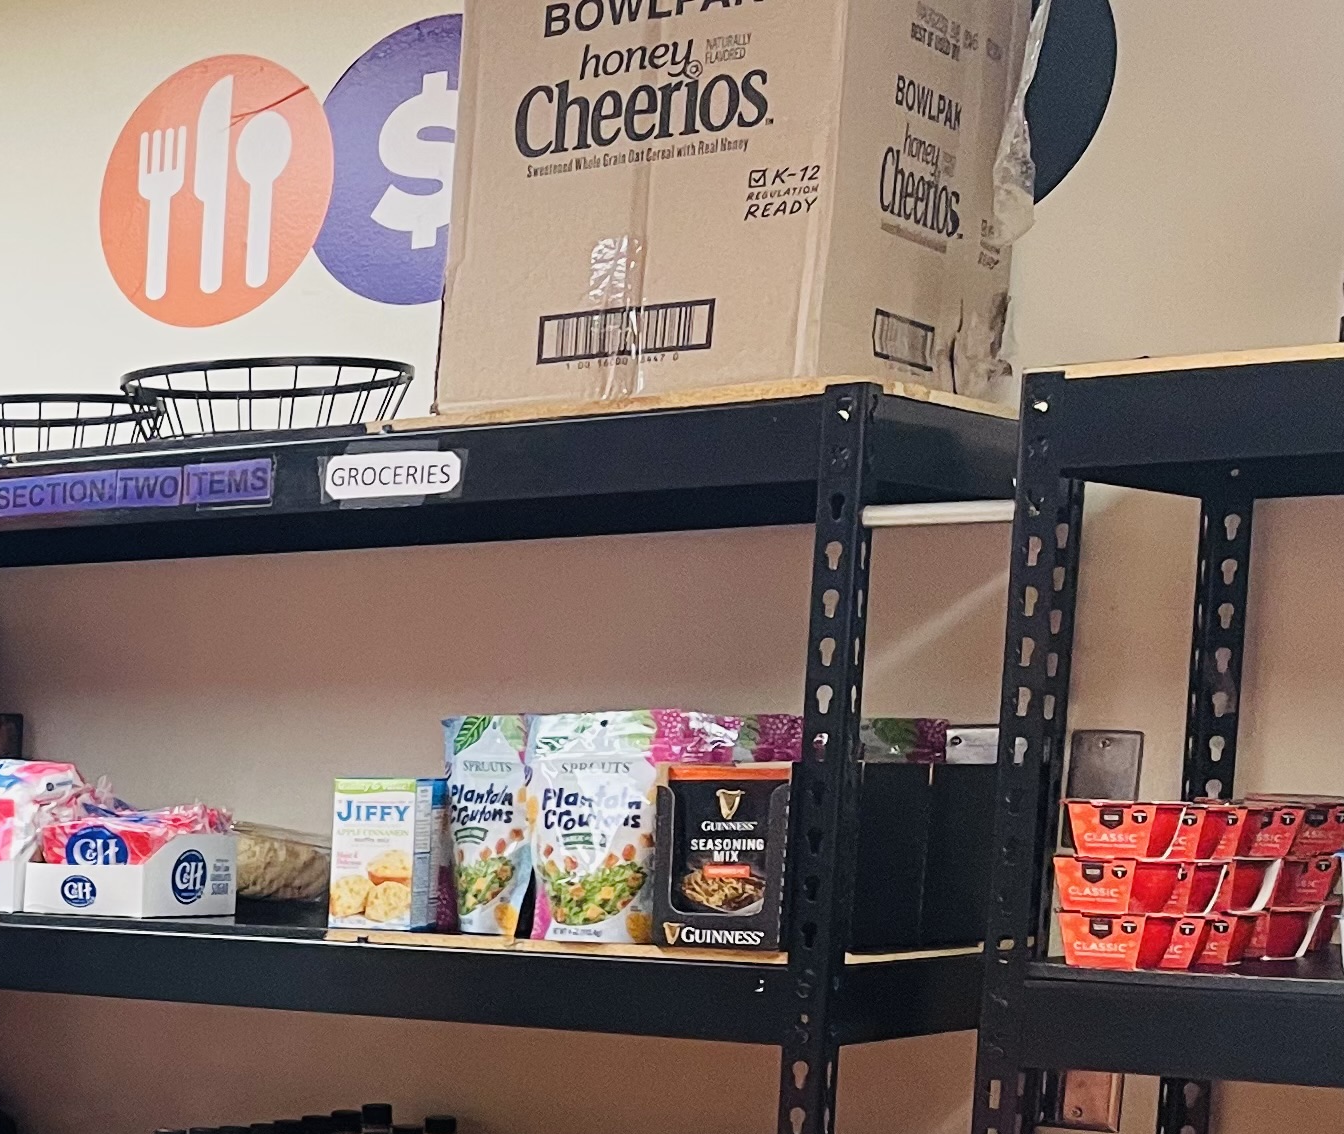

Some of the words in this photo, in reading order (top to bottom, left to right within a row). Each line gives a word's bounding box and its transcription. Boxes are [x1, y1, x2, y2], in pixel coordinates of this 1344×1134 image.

[579, 38, 694, 80] honey
[514, 68, 769, 158] Cheerios
[895, 74, 962, 132] BOWLPAK
[574, 155, 601, 172] Whole
[603, 151, 626, 167] Grain
[676, 141, 696, 158] with
[698, 138, 719, 156] Real
[771, 165, 820, 186] K-12
[746, 183, 820, 203] REGULATION
[879, 145, 961, 239] Cheerios
[743, 197, 818, 221] READY
[118, 474, 179, 502] TWO
[183, 466, 269, 498] ITEMS
[330, 464, 452, 488] GROCERIES
[450, 783, 514, 808] Plantain
[336, 800, 411, 822] JIFFY
[450, 806, 514, 826] Croutons
[701, 820, 756, 832] GUINNESS
[690, 838, 765, 852] SEASONING
[1083, 831, 1137, 844] CLASSIC
[713, 849, 739, 863] MIX
[174, 860, 204, 893] C&H
[64, 881, 95, 901] C&H
[1068, 884, 1120, 898] CLASSIC
[680, 925, 763, 945] GUINNESS
[1073, 940, 1127, 954] CLASSIC
